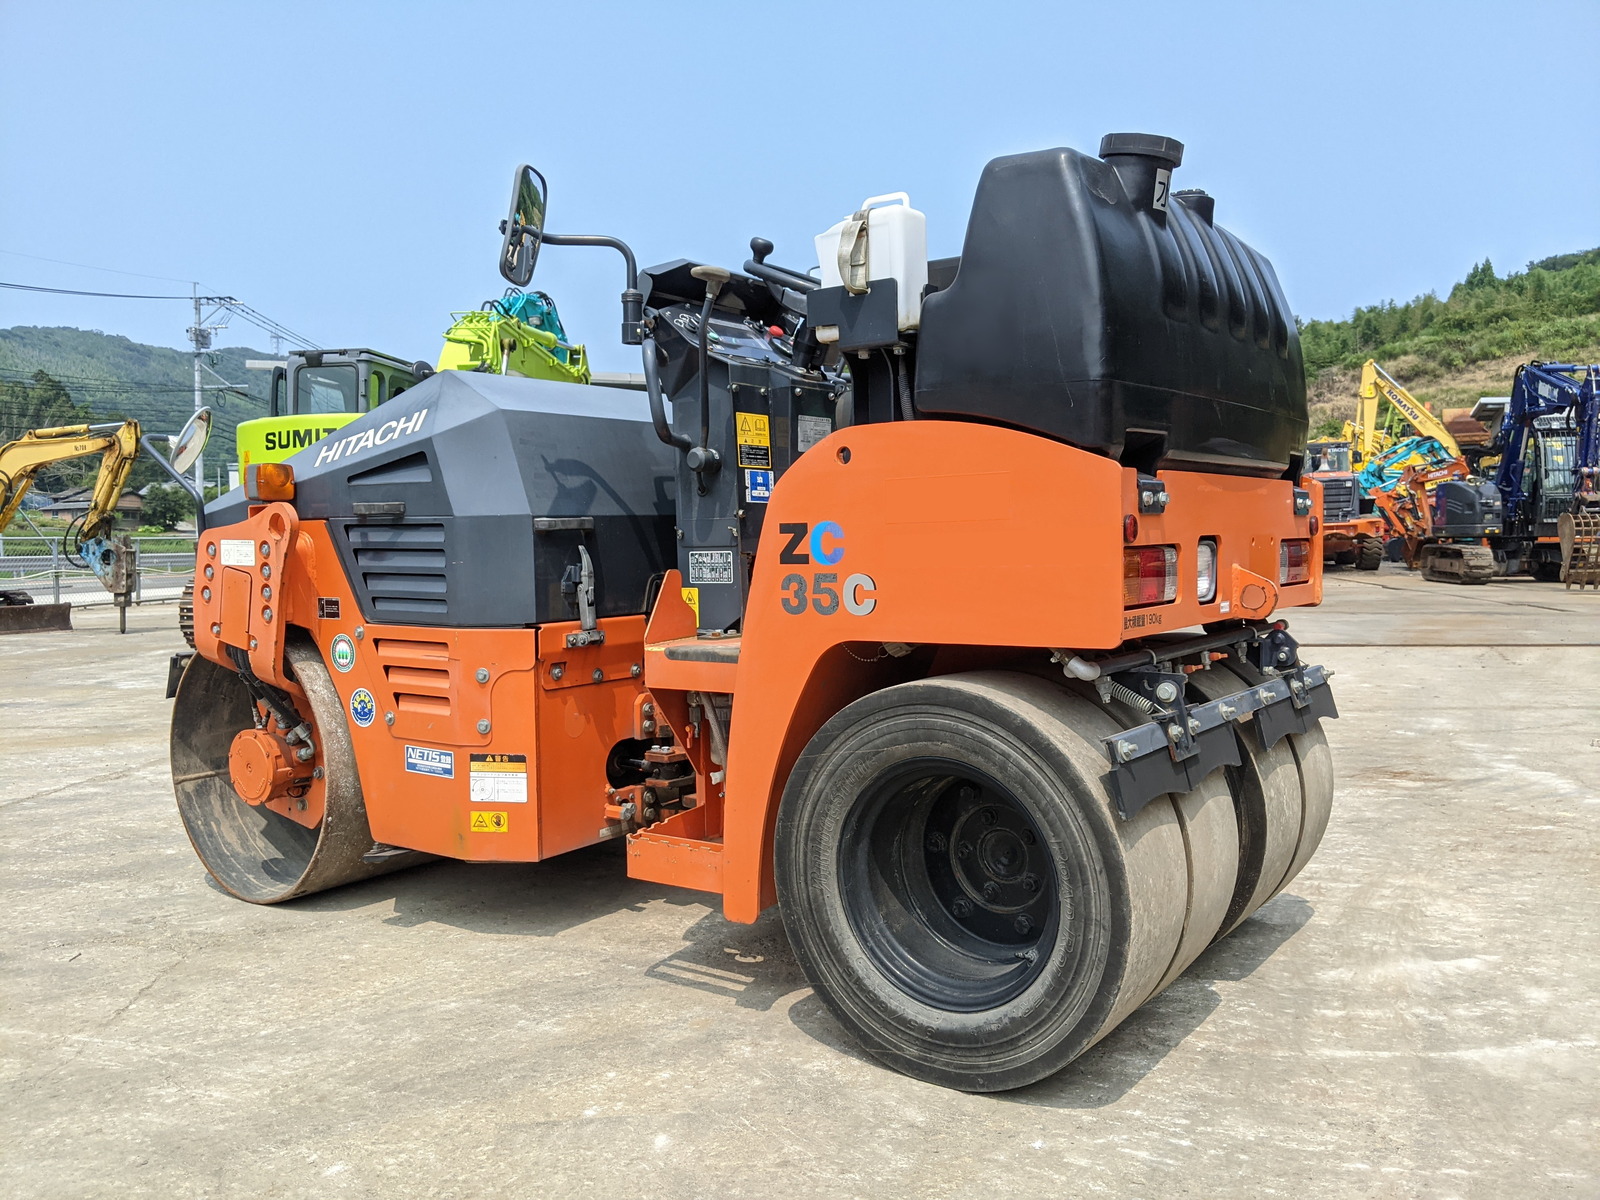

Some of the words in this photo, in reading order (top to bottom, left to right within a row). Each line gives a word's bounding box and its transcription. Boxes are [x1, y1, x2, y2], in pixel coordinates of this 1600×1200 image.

[1386, 389, 1419, 421] KOMATSU
[313, 409, 429, 468] HITACHI
[1427, 469, 1448, 479] HITACHI
[779, 520, 845, 566] ZC
[781, 573, 877, 616] 35C
[407, 748, 440, 763] NETIS
